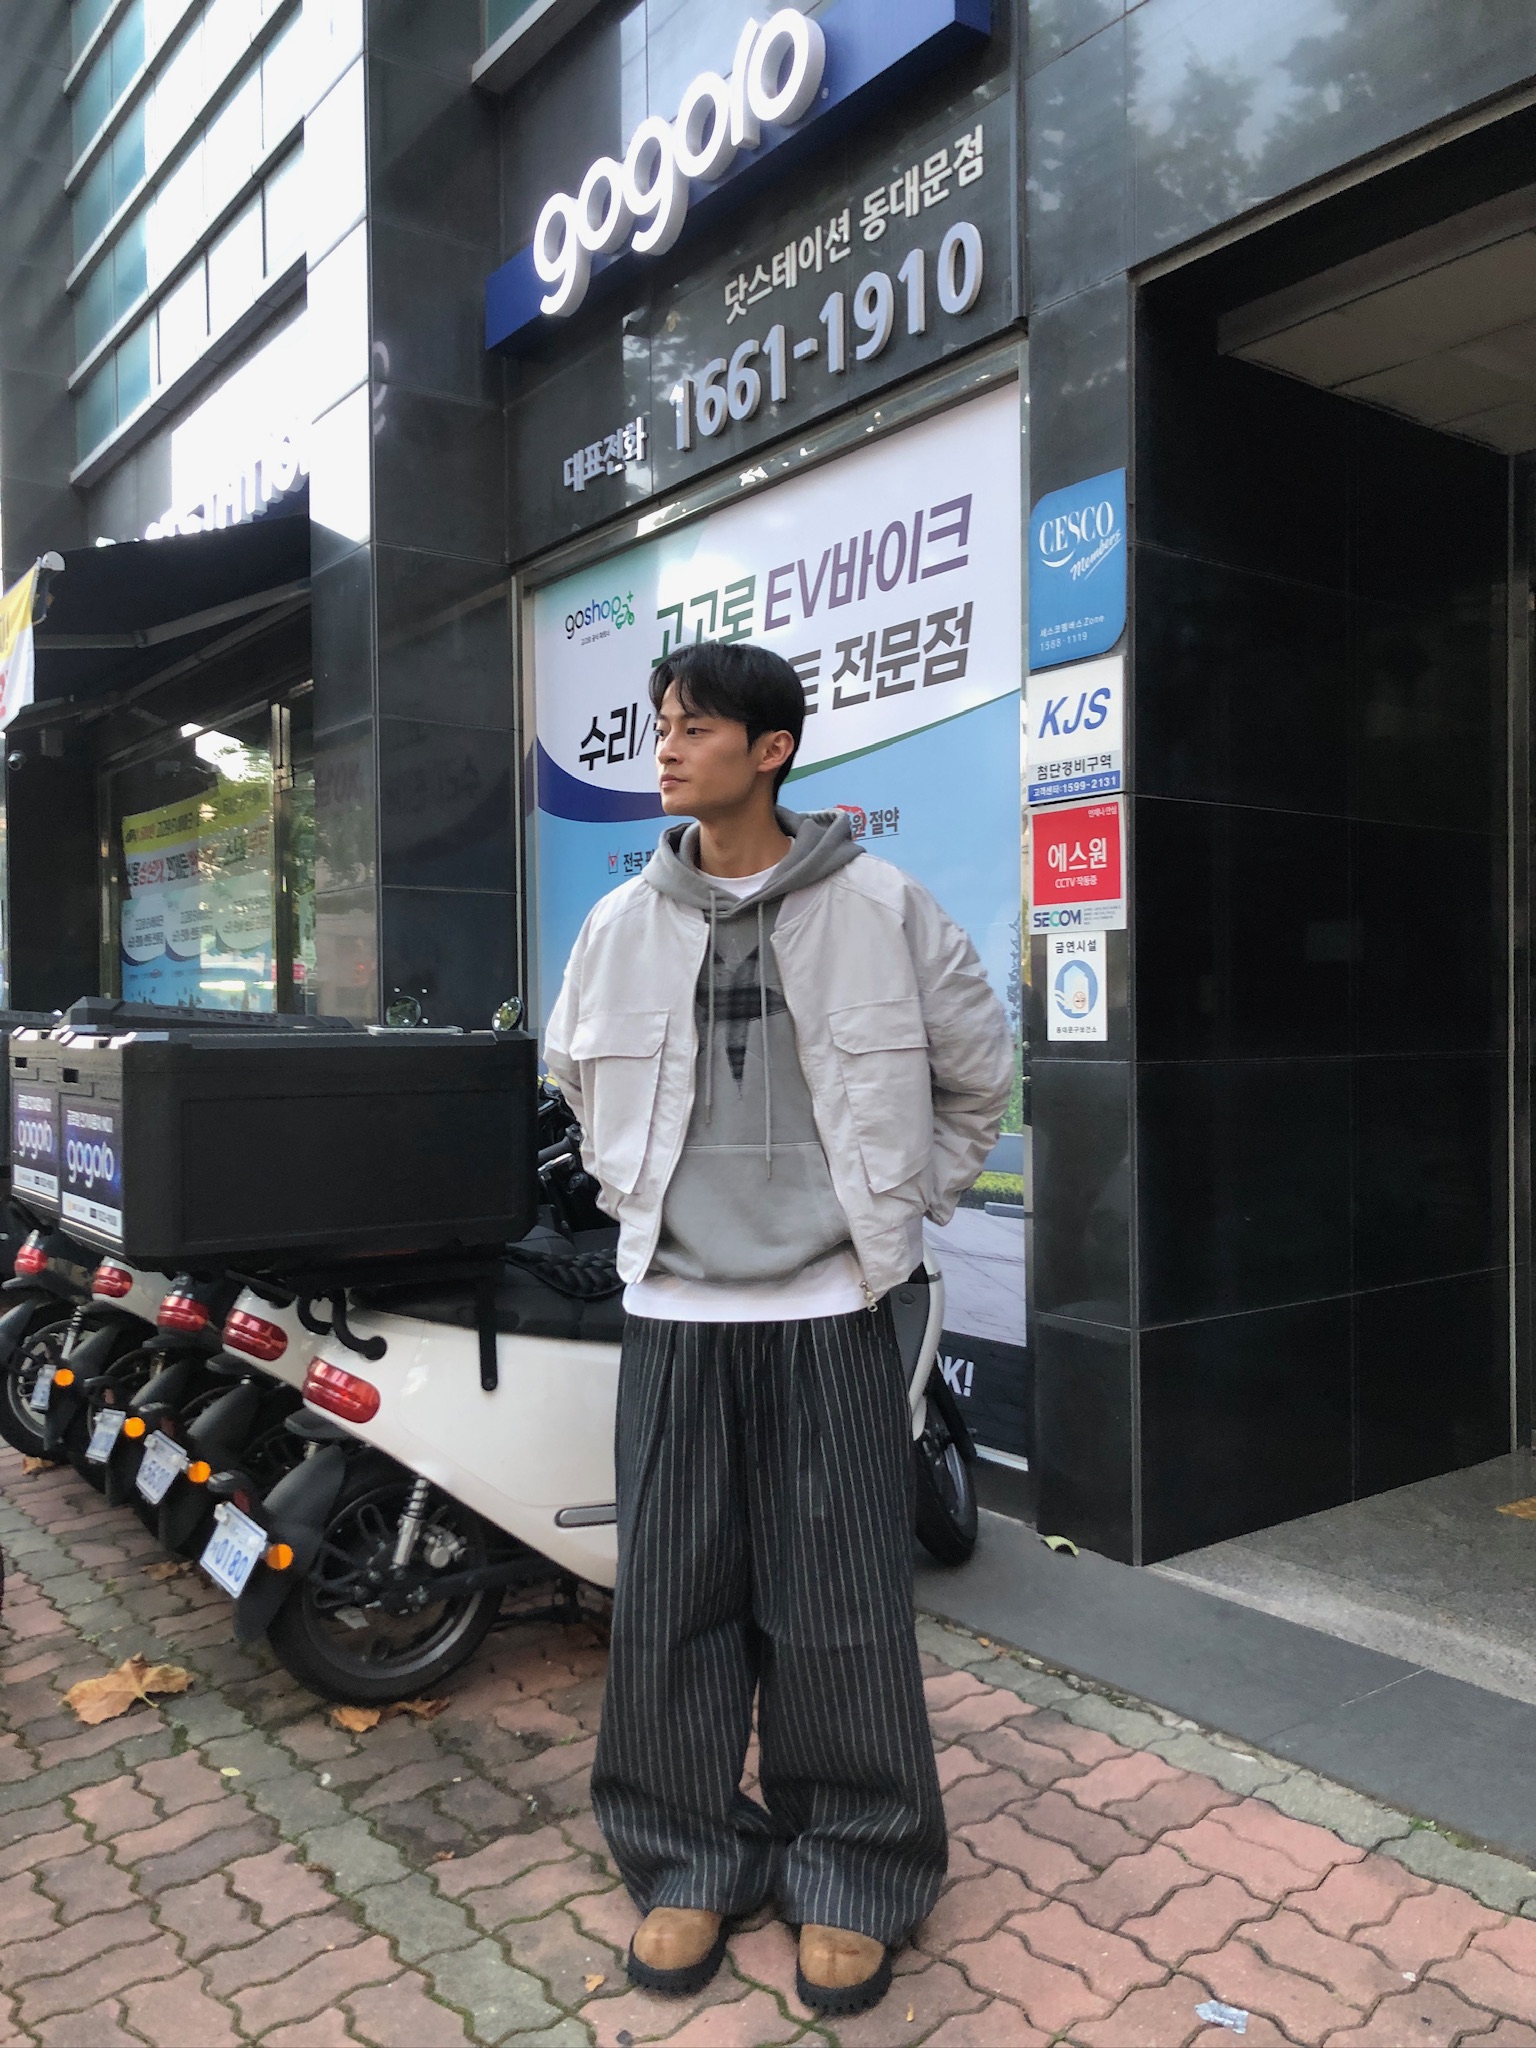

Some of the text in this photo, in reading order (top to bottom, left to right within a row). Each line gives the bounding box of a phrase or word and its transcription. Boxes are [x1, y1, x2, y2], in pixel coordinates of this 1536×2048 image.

[533, 8, 827, 318] gogolo
[724, 124, 986, 326] 닷스테이션 동대문점
[563, 220, 984, 492] 대표전화 1661-1910
[1039, 501, 1114, 556] CESCO
[1070, 528, 1121, 581] Members
[651, 493, 973, 668] 고고로 EV바이크
[578, 702, 658, 771] 수리/
[831, 601, 974, 710] 전문점
[1038, 687, 1111, 739] KJS
[1037, 754, 1112, 781] 첨단경비구역
[869, 806, 900, 836] 절약
[623, 850, 644, 873] 전국
[1047, 837, 1108, 873] 에스원
[1033, 909, 1082, 928] SECOM
[1055, 939, 1097, 955] 금연시설
[17, 1119, 53, 1160] gogolo
[66, 1139, 115, 1189] gogolo
[937, 1353, 975, 1398] K!
